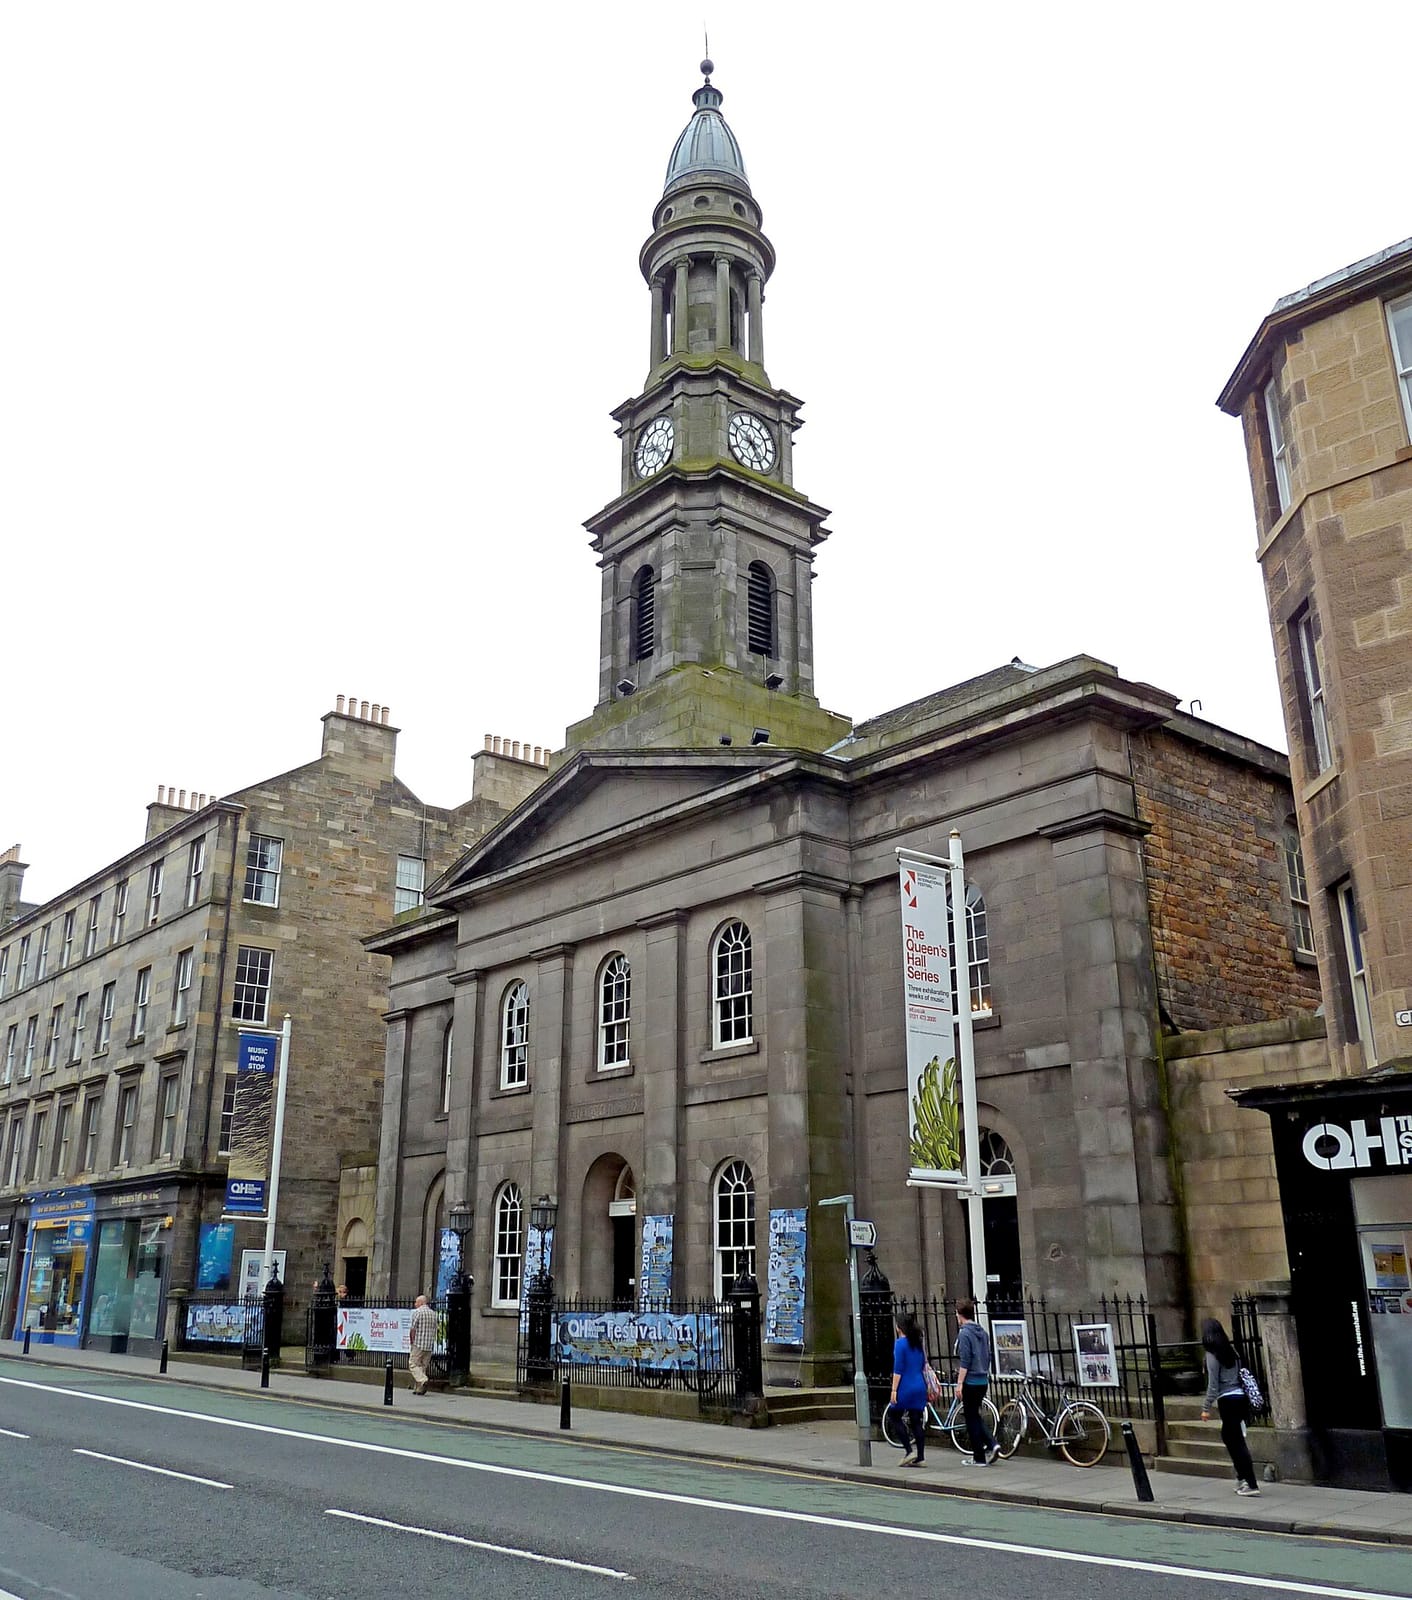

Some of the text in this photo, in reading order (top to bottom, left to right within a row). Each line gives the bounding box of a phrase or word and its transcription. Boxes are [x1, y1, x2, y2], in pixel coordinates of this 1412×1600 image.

[904, 924, 925, 940] The
[906, 938, 948, 958] Queen's
[906, 951, 927, 968] Hall
[907, 965, 940, 984] Series
[247, 1046, 268, 1055] MUSIC
[249, 1054, 265, 1062] NON
[247, 1062, 266, 1071] STOP
[1302, 1116, 1401, 1171] QH
[230, 1182, 248, 1195] QH
[769, 1215, 790, 1234] QH
[766, 1275, 778, 1338] Festival
[568, 1318, 588, 1339] QH
[606, 1319, 663, 1342] Festival
[665, 1325, 693, 1341] 2011
[1350, 1301, 1366, 1376] www.theueenshall.net
